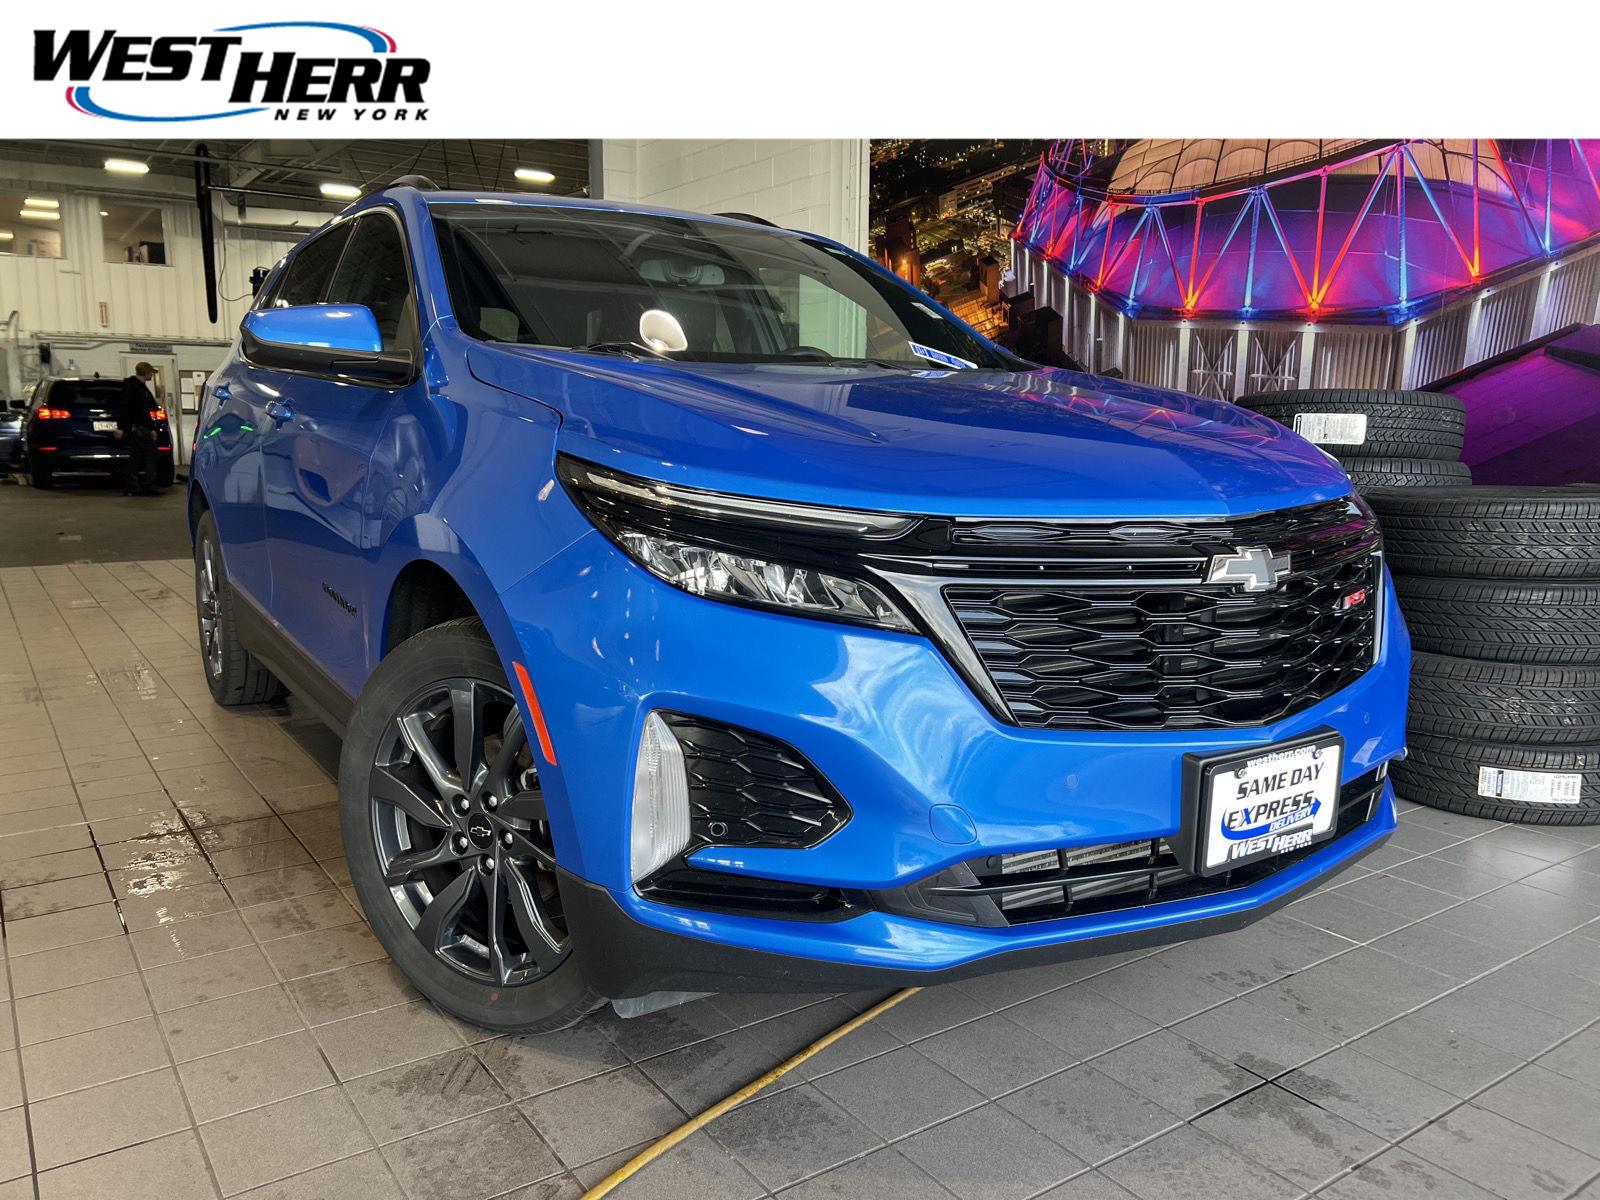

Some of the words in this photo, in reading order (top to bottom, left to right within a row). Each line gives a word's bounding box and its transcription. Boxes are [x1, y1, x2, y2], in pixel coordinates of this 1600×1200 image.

[1236, 771, 1288, 800] SAME
[1290, 762, 1325, 787] DAY
[1226, 790, 1315, 830] EXPRESS
[1269, 805, 1313, 832] DELIVERY
[1231, 833, 1277, 860] WEST
[1271, 829, 1312, 852] HERR
